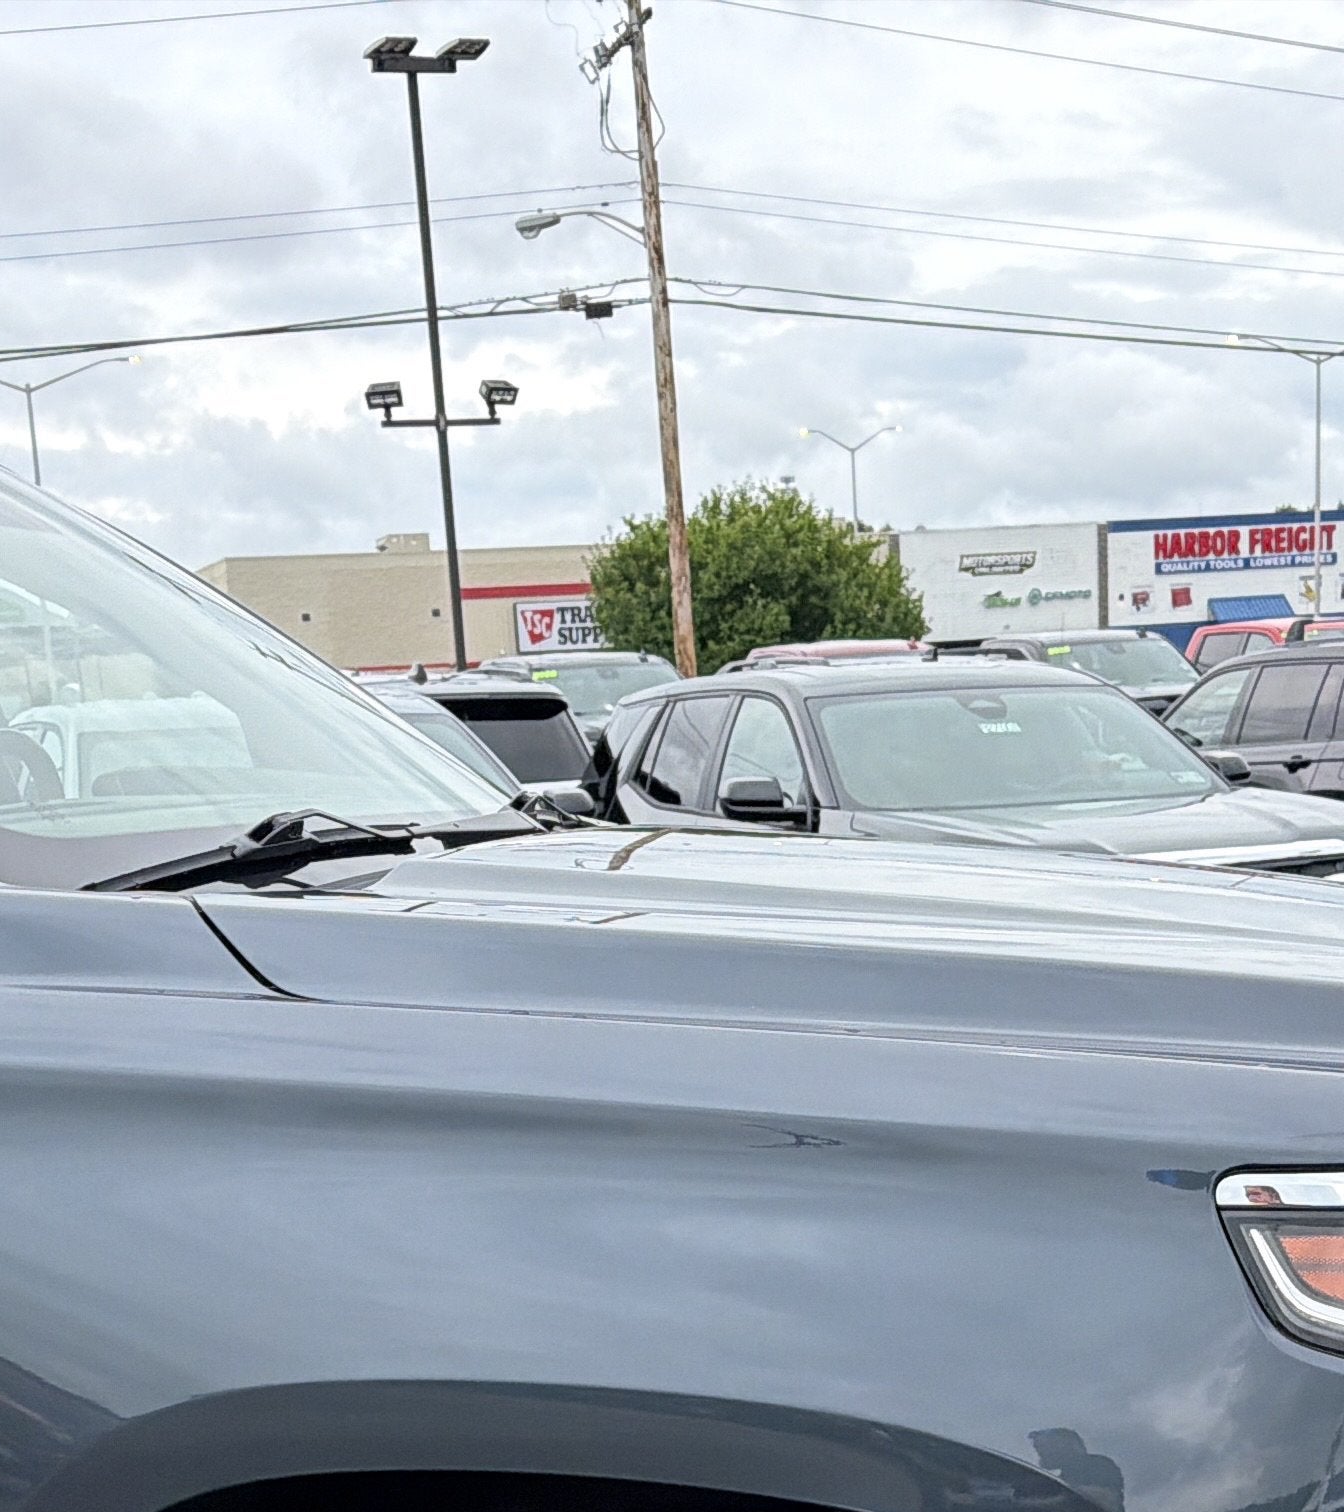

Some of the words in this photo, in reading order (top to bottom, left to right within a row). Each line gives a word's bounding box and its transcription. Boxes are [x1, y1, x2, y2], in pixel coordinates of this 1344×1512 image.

[1154, 529, 1241, 560] HARBOR
[1160, 561, 1207, 572] QUALITY
[1209, 559, 1244, 569] TOOLS
[1249, 556, 1292, 567] LOWEST
[1294, 554, 1333, 565] PRIES
[524, 611, 551, 638] TSC
